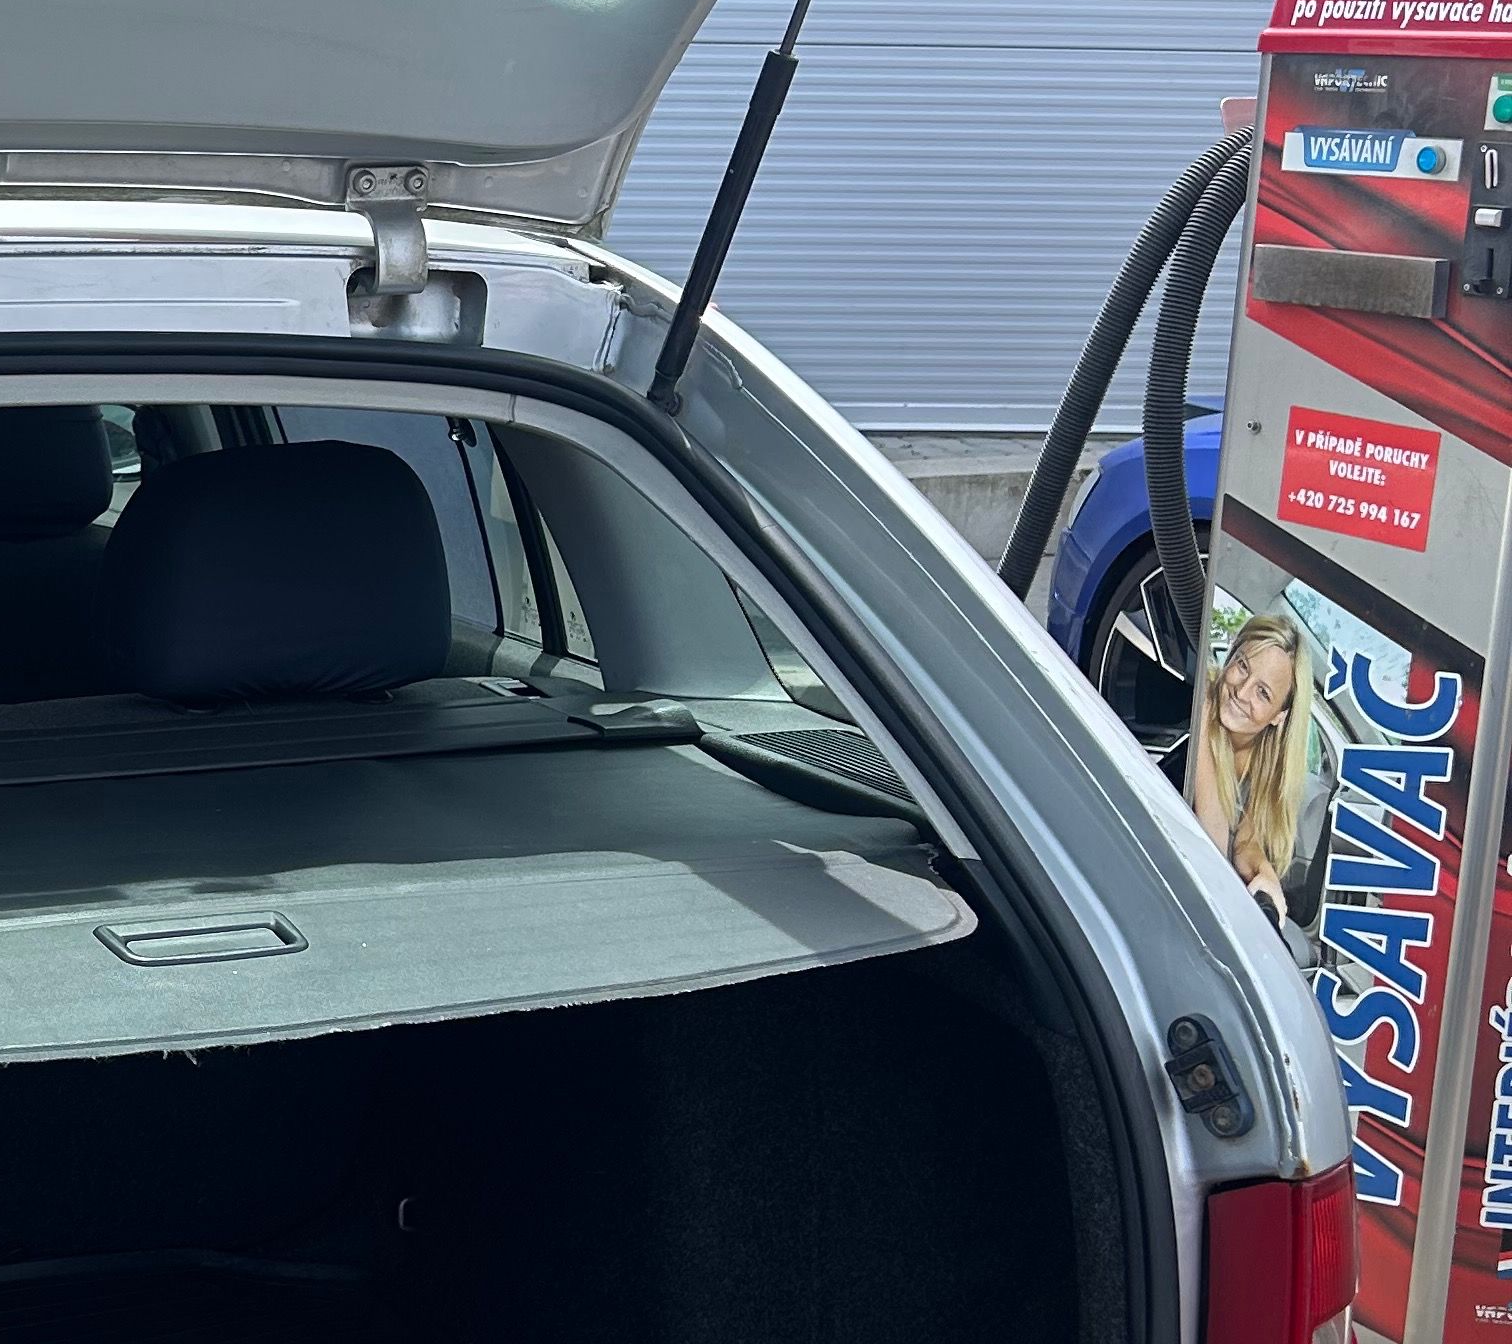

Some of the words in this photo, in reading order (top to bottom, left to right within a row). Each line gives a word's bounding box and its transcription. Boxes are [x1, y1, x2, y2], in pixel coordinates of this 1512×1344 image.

[1291, 0, 1317, 26] po
[1310, 133, 1395, 165] VYSÁVÁNÍ
[1295, 429, 1305, 446] V
[1307, 429, 1363, 457] PŘÍPADĚ
[1365, 443, 1430, 470] PORUCHY
[1329, 459, 1387, 487] VOLEJTE:
[1288, 488, 1324, 509] +420
[1327, 494, 1356, 516] 725
[1359, 502, 1388, 523] 994
[1393, 508, 1421, 530] 167
